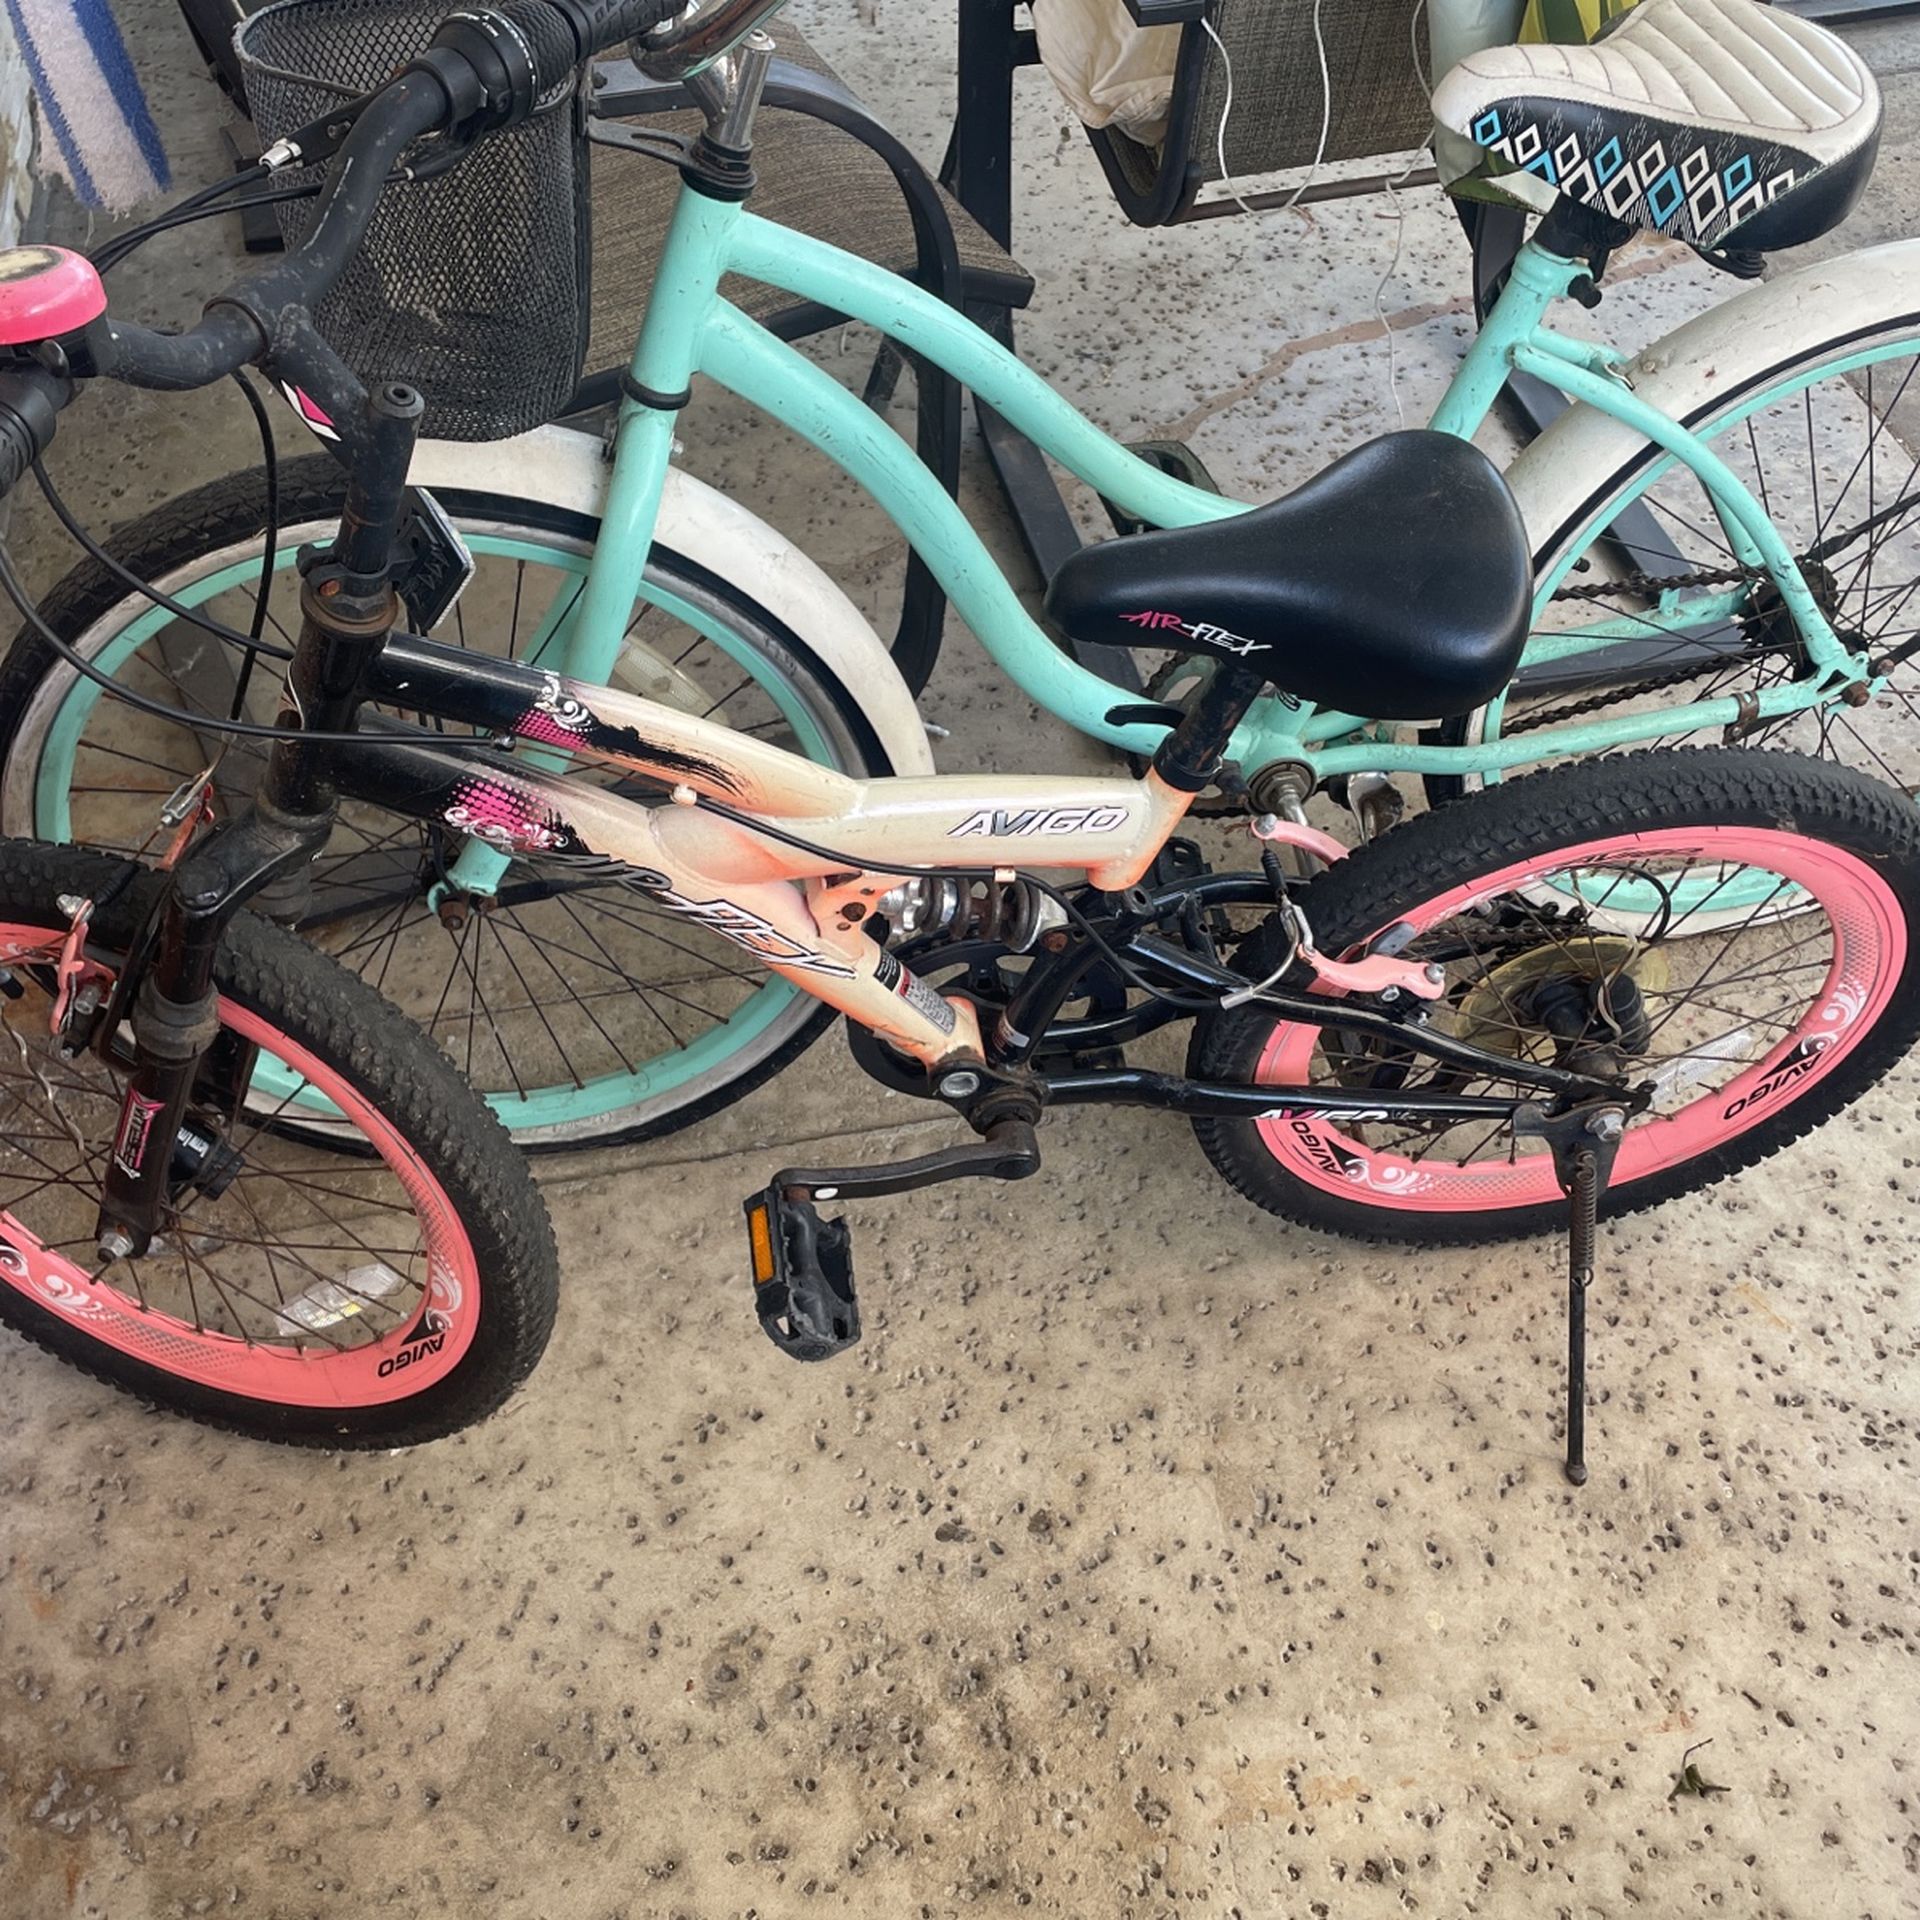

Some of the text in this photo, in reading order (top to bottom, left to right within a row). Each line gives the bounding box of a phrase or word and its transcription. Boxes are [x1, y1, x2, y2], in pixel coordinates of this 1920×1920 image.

[947, 805, 1130, 837] AVIGO
[1723, 1052, 1823, 1120] AVIGO
[1291, 1121, 1343, 1175] AVIGO
[378, 1332, 446, 1378] AVIGO
